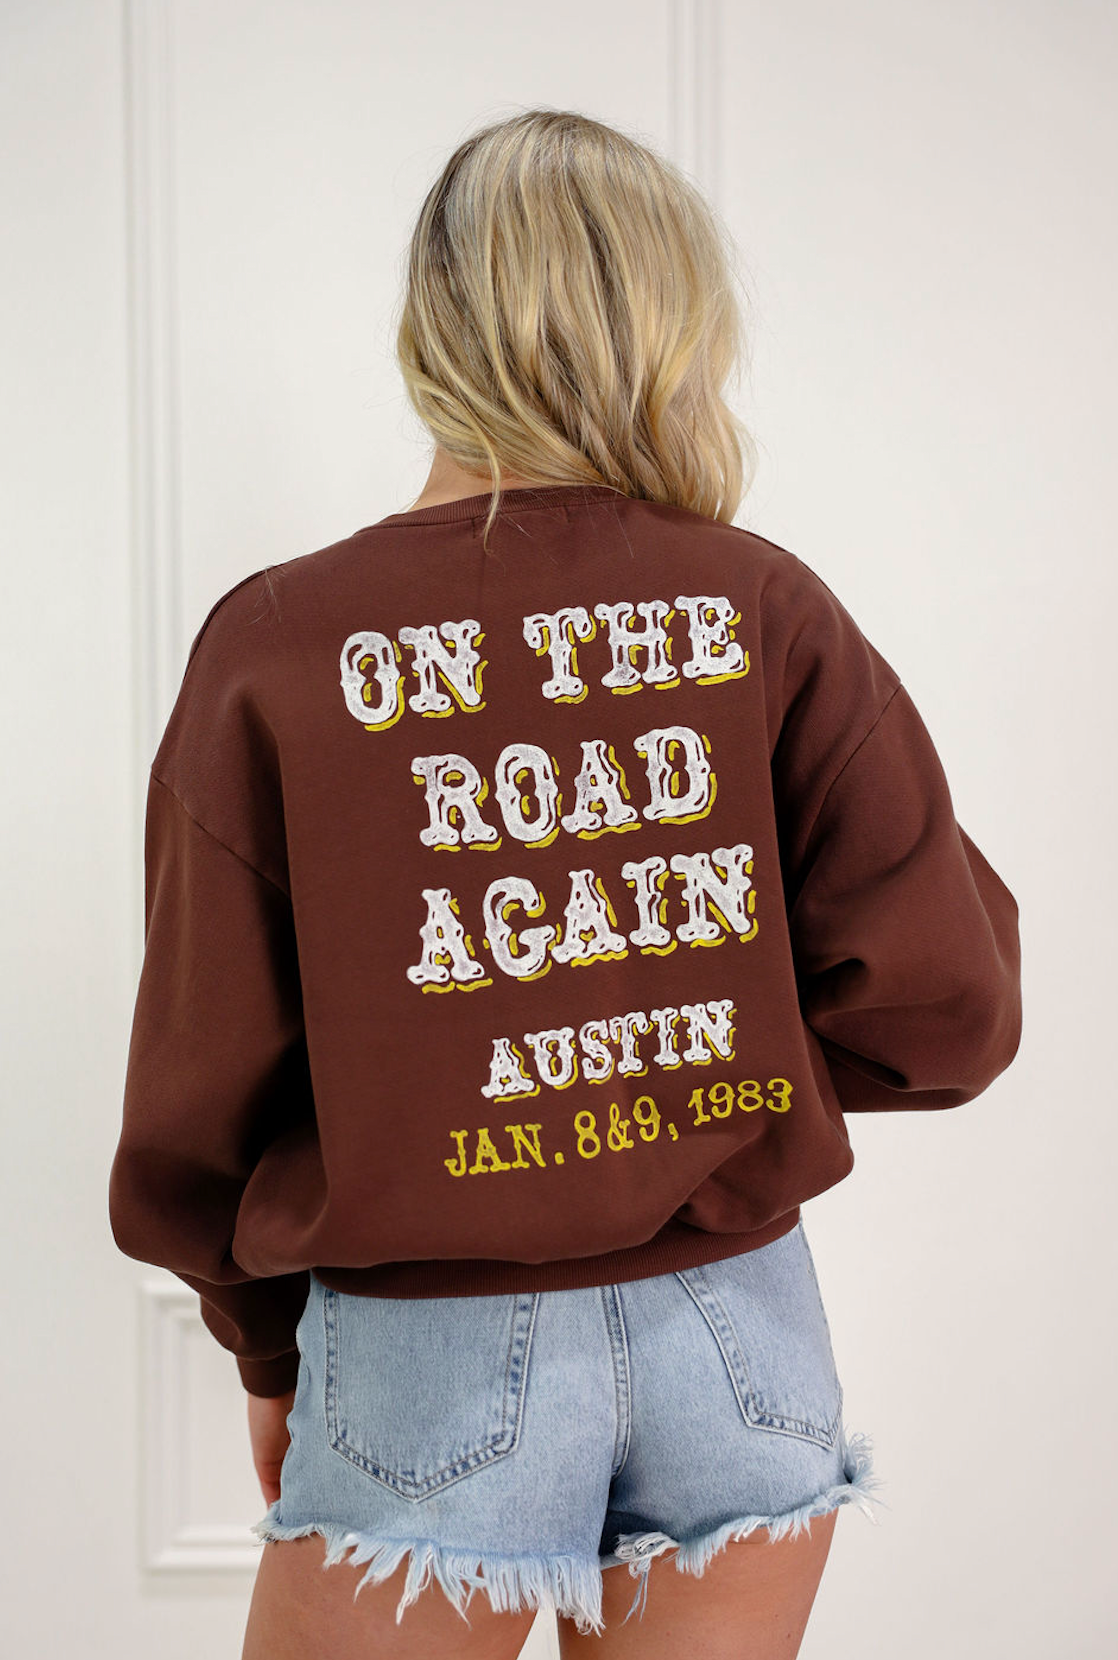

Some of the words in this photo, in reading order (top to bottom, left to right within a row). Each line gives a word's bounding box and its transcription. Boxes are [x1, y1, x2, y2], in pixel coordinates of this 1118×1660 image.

[339, 618, 488, 731] ON
[522, 595, 750, 704] THE
[410, 725, 718, 852] ROAD
[406, 843, 758, 993] AGAIN
[481, 998, 737, 1102] AUSTIN
[444, 1123, 565, 1177] JAN.
[687, 1078, 793, 1127] 1983
